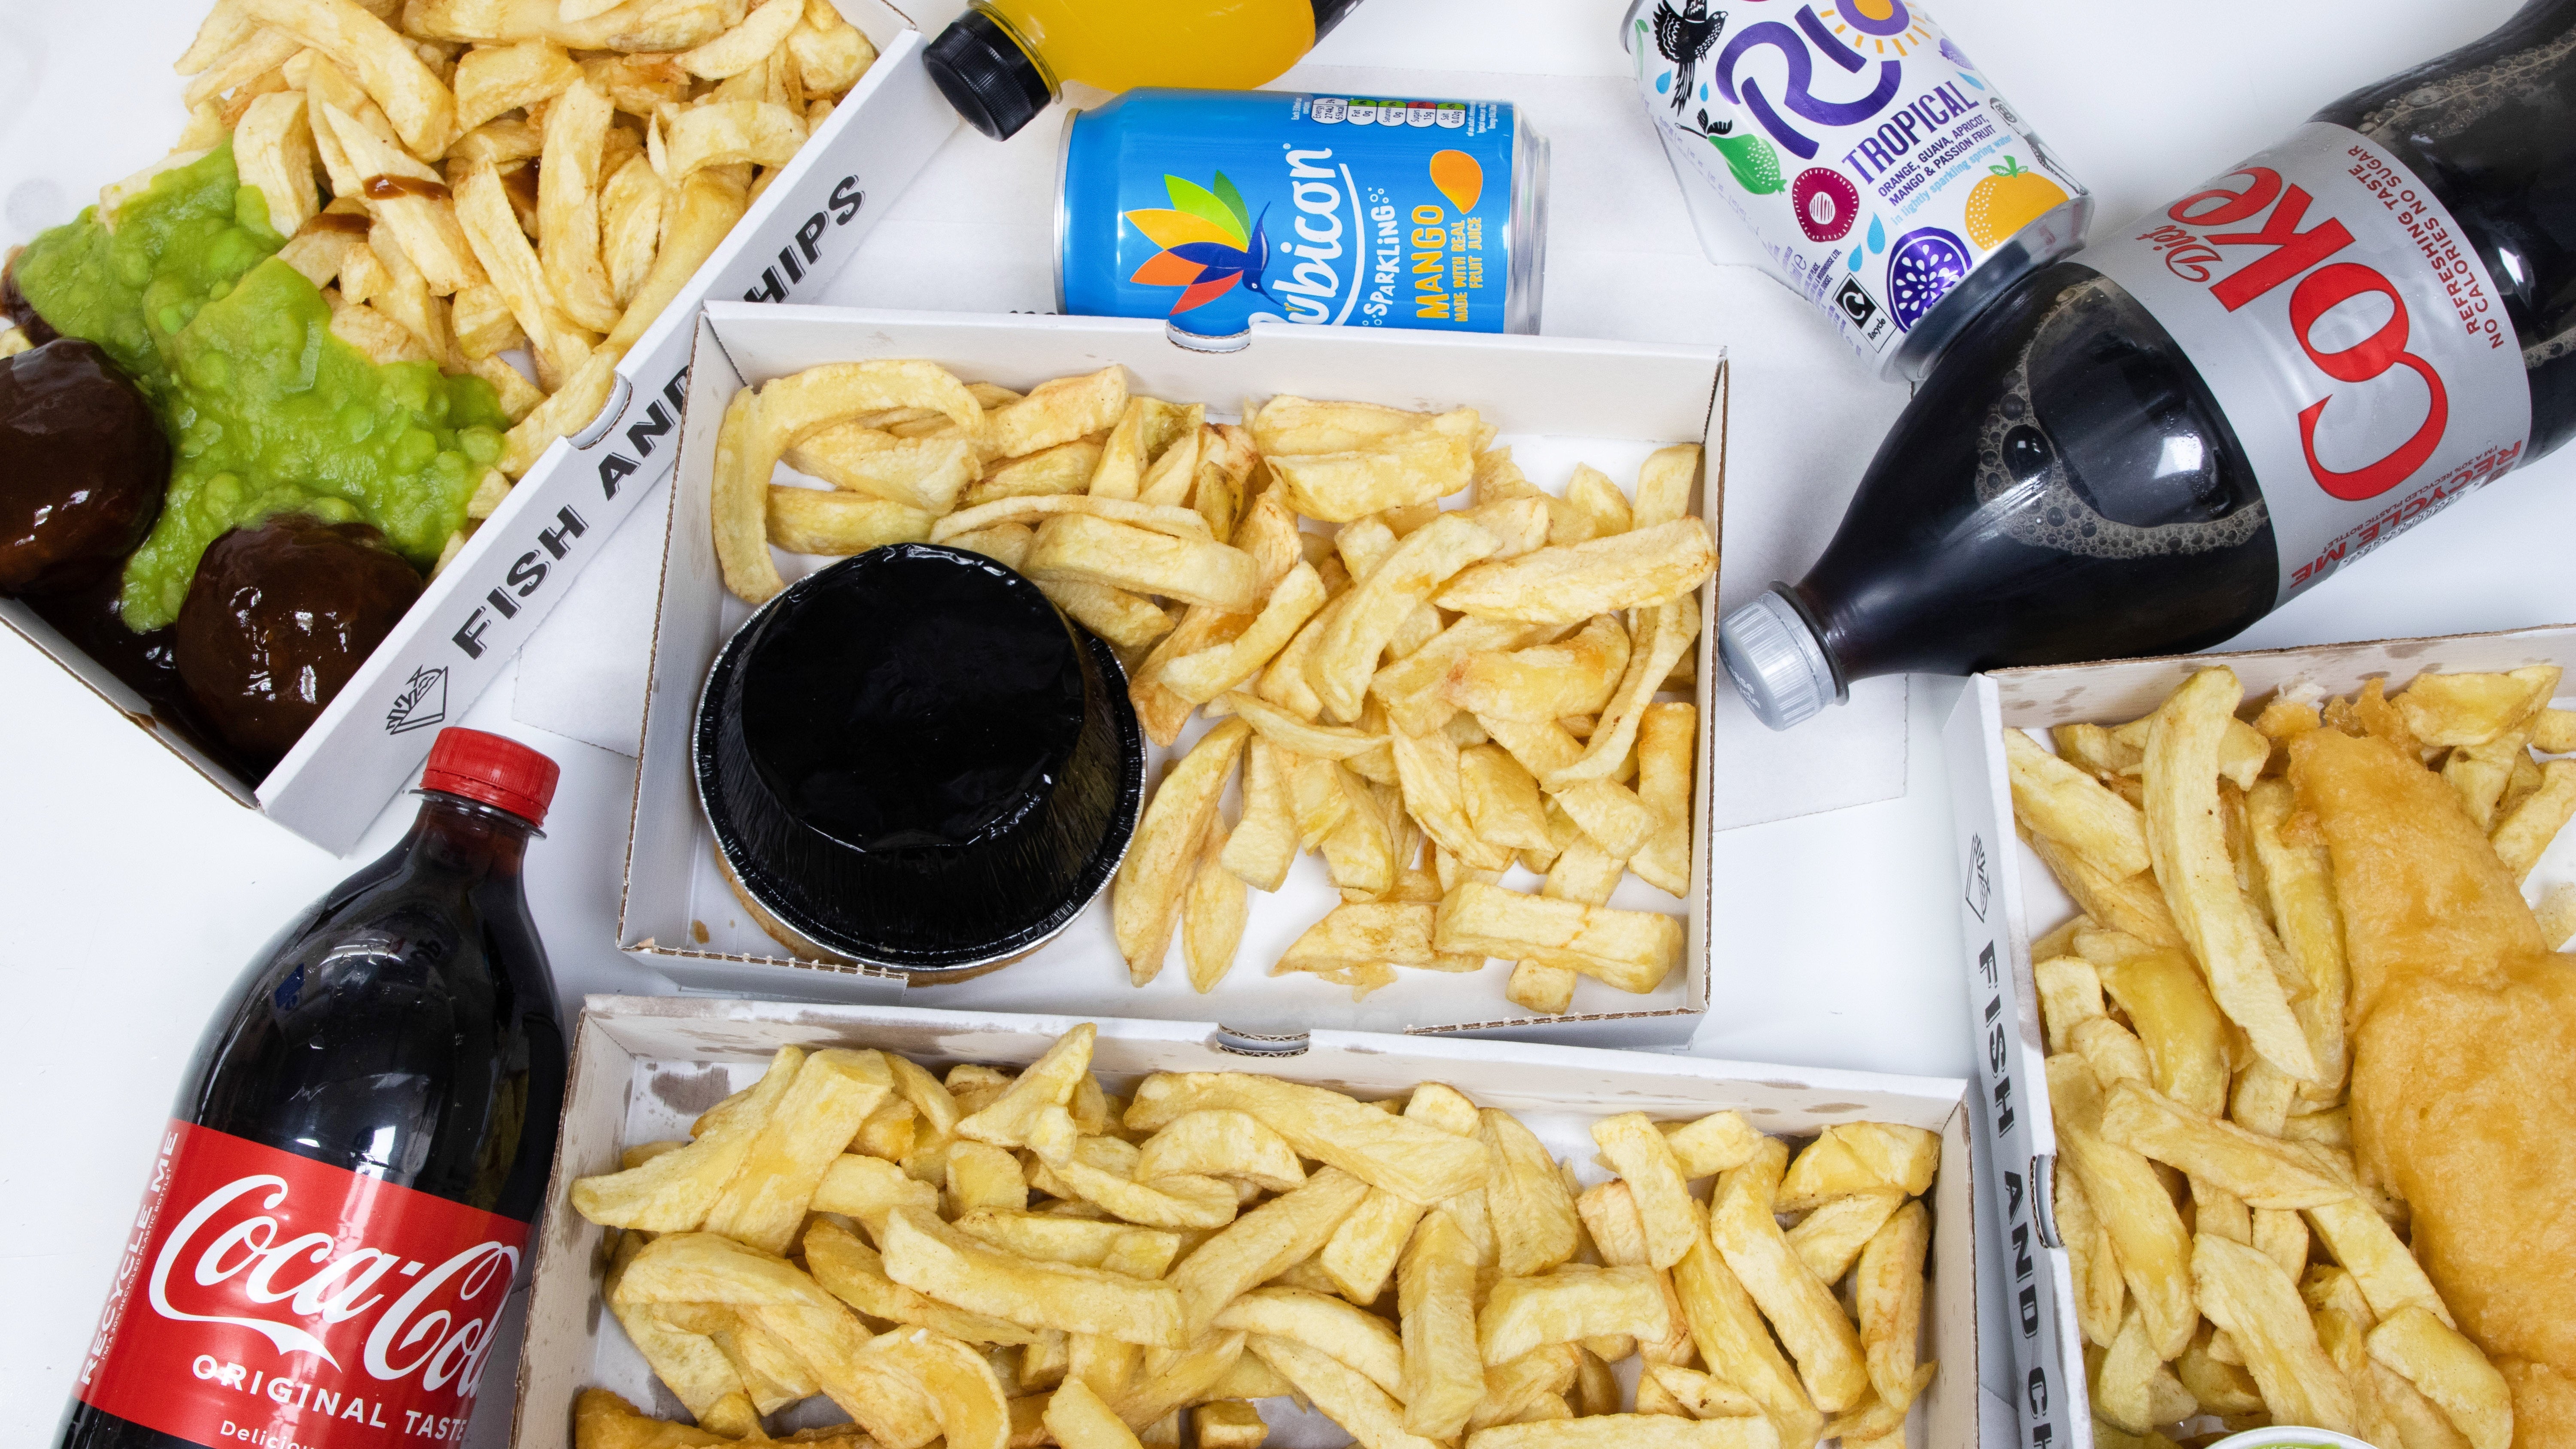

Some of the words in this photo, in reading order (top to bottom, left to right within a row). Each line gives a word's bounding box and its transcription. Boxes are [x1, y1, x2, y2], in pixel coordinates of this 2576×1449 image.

[1313, 106, 1324, 118] Energy
[1335, 106, 1344, 120] 65kcal
[1411, 109, 1422, 122] Sugars
[1451, 111, 1462, 124] 0.02g
[1841, 81, 1979, 185] TROPICAL
[1878, 161, 1921, 197] ORANGE,
[1918, 137, 1954, 163] GUAVA,
[1952, 114, 1990, 140] APRICOT,
[1889, 173, 1925, 206] MANGO
[1924, 167, 1936, 176] &
[1933, 138, 1974, 169] PASSION
[1971, 125, 1996, 143] FRUIT
[2348, 145, 2402, 188] SUGAR
[1891, 215, 1903, 225] in
[1901, 191, 1931, 216] lightly
[1929, 161, 1971, 191] sparkling
[1968, 144, 1996, 164] spring
[1993, 135, 2013, 148] water
[2348, 164, 2399, 210] TASTE
[2400, 190, 2428, 215] NO
[1248, 148, 1343, 325] ubicon
[1451, 220, 1466, 252] REAL
[1467, 217, 1482, 250] JUICE
[2135, 225, 2223, 282] Diet
[1411, 205, 1449, 319] MANGO
[1452, 257, 1467, 288] WITH
[1468, 256, 1483, 289] FRUIT
[2397, 212, 2481, 335] REFRESHING
[2424, 217, 2489, 313] CALORIES
[1454, 292, 1468, 322] MADE
[1868, 318, 1886, 341] Recycle
[2167, 167, 2448, 501] Coke
[2484, 319, 2504, 349] NO
[452, 504, 590, 660] FISH
[743, 175, 867, 304] HIPS
[2405, 471, 2452, 503] RECYCLED
[2454, 459, 2474, 472] 30%
[2356, 439, 2522, 549] RECYCLE
[2365, 500, 2403, 526] PLASTIC
[2290, 542, 2347, 589] ME
[1978, 939, 2015, 1138] FISH
[2004, 1170, 2038, 1340] AND
[80, 1204, 153, 1385] RECYCLE
[150, 1131, 179, 1193] ME
[111, 1312, 121, 1334] 30%
[119, 1258, 141, 1310] RECYCLED
[139, 1213, 156, 1255] PLASTIC
[192, 1355, 386, 1429] ORIGINAL
[404, 1410, 467, 1442] TASTE
